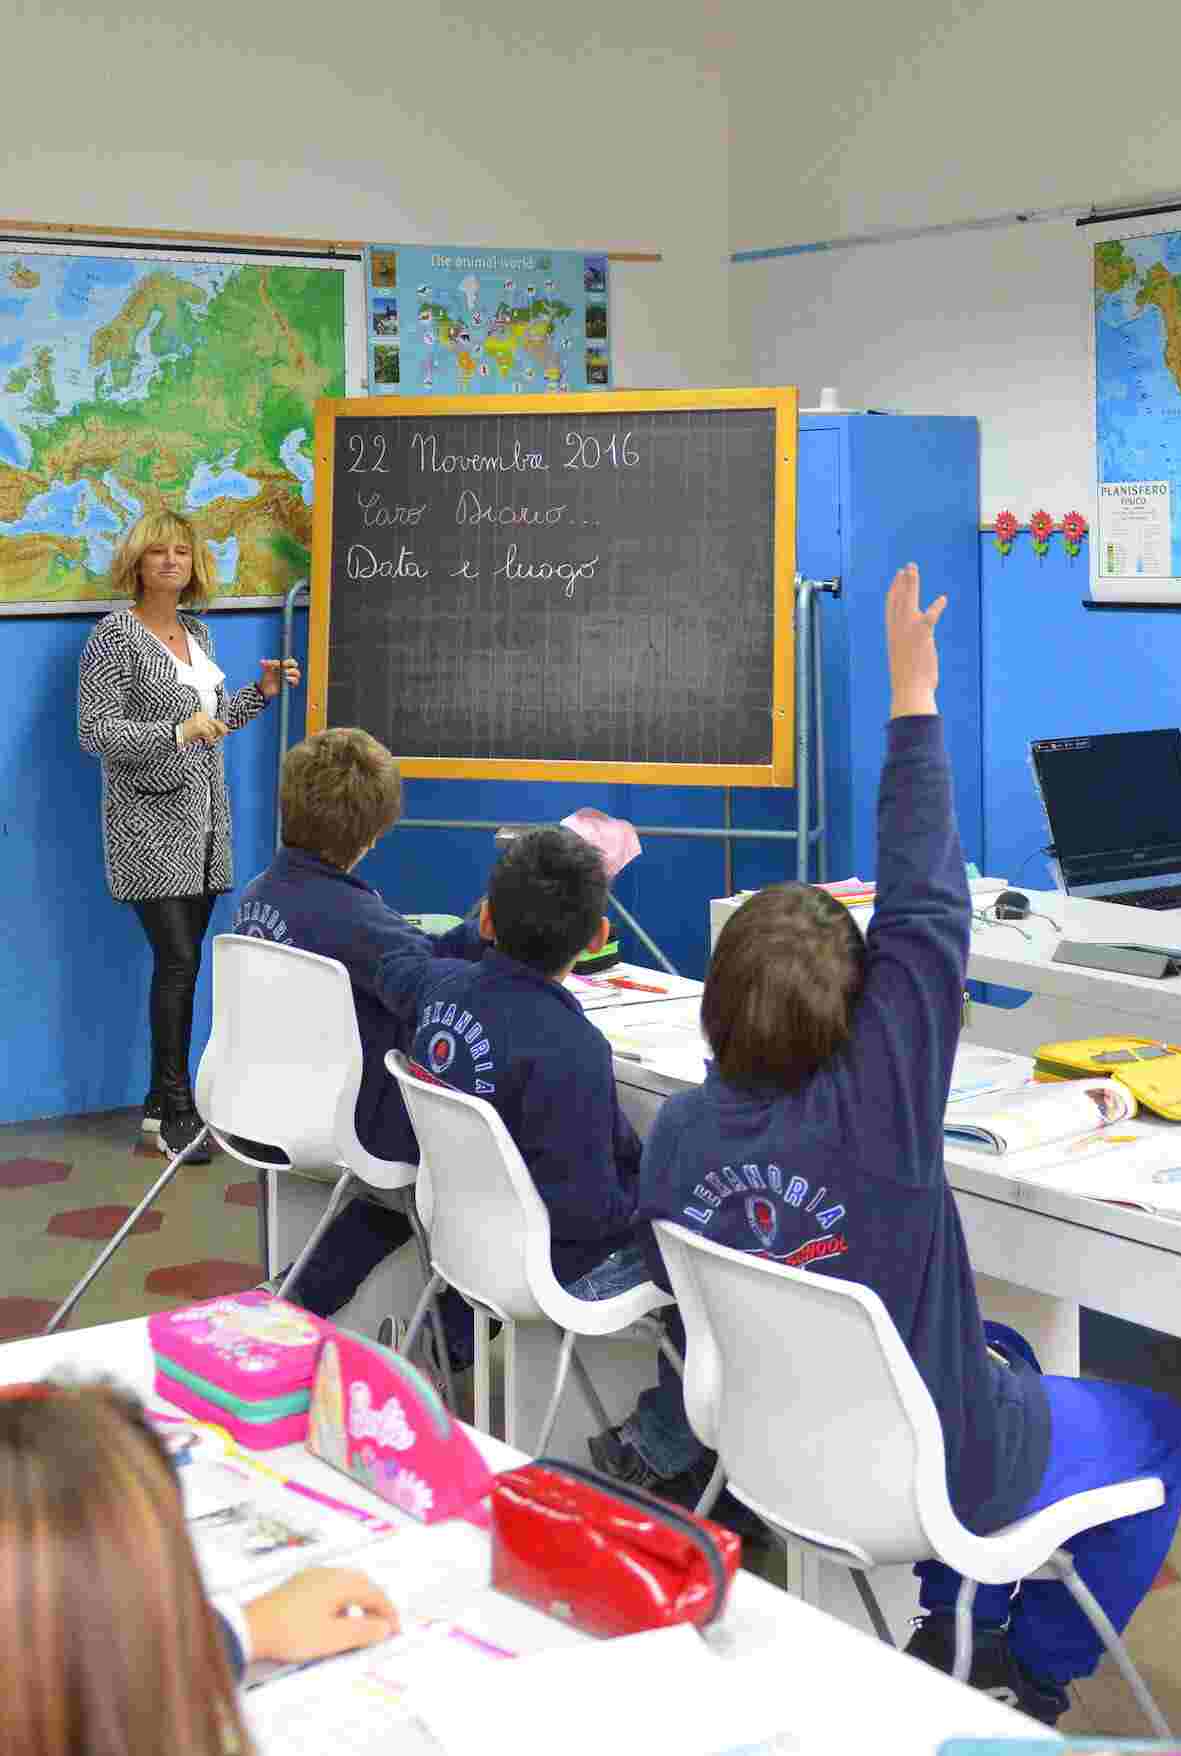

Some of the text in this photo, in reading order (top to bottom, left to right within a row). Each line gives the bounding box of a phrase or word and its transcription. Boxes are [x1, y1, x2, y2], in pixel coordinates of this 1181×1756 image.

[347, 431, 640, 473] 22 Novembre 2016
[358, 488, 428, 527] Caro
[1102, 484, 1167, 497] PLANISFERO
[346, 543, 600, 598] Data e luogo
[415, 1001, 496, 1093] EXANDRIA
[682, 1164, 846, 1230] LEXANDRIA
